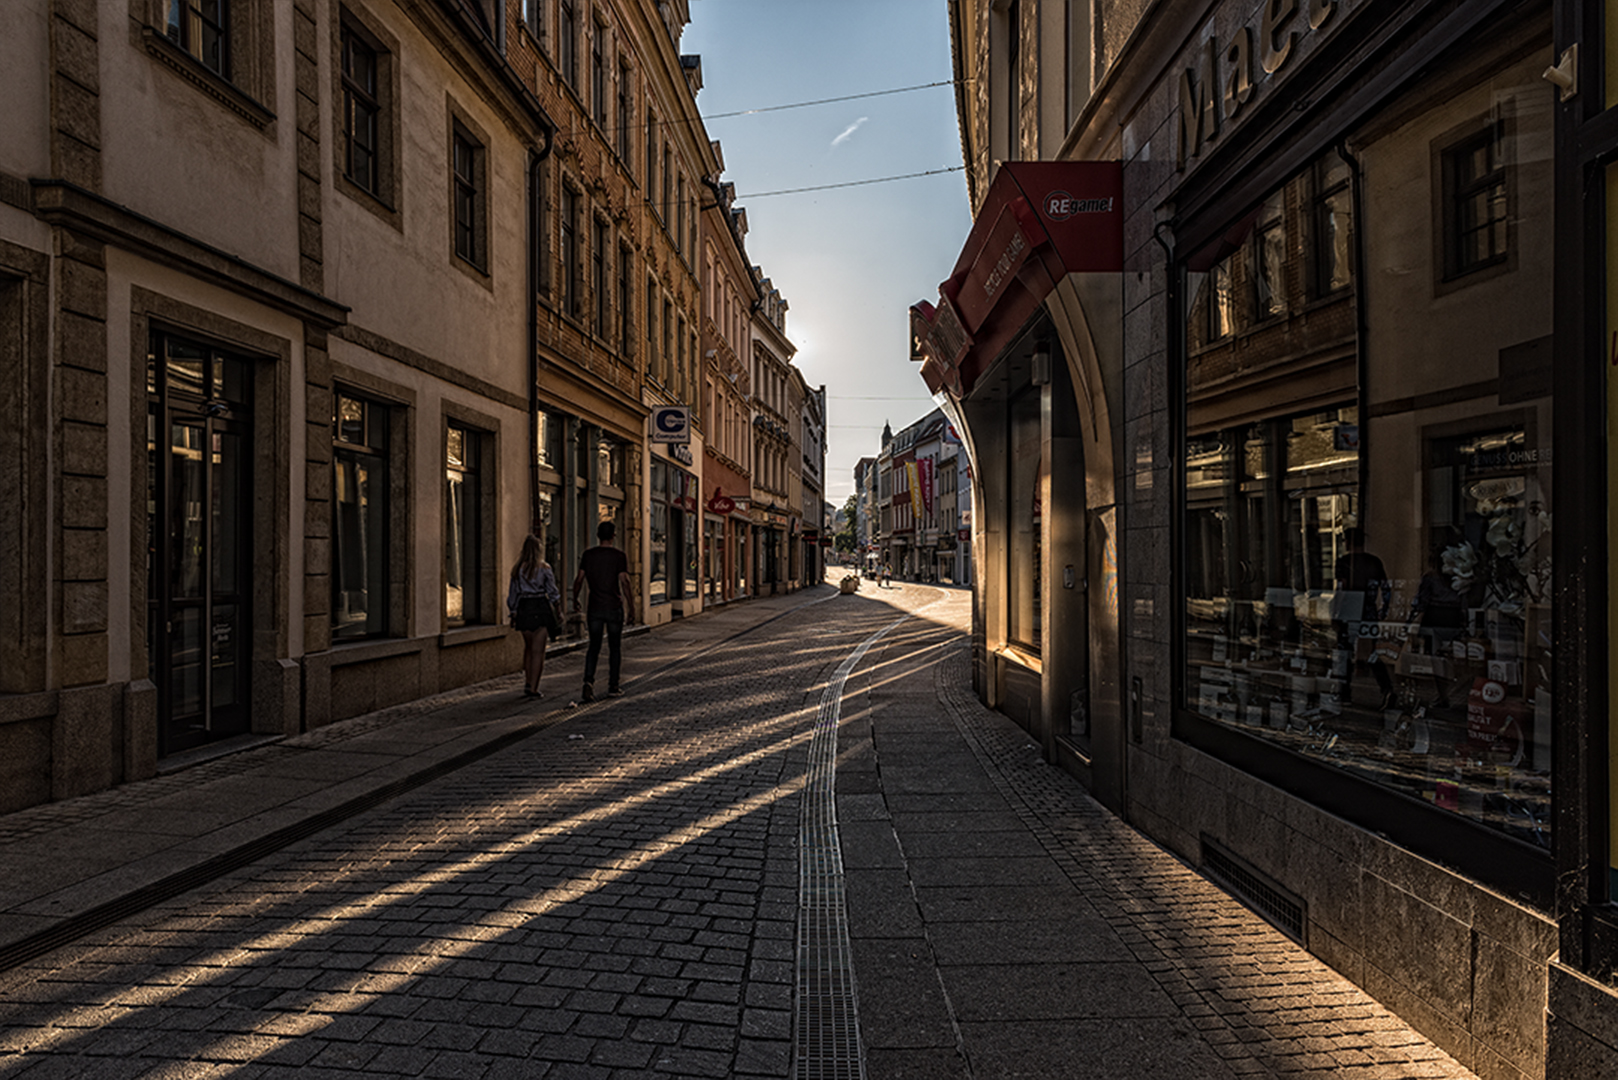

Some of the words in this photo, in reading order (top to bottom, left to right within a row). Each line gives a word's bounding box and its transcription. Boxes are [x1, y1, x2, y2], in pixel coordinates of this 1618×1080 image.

[1044, 193, 1114, 217] REgame!
[1508, 449, 1538, 463] OHNE
[1359, 623, 1409, 638] COHIB
